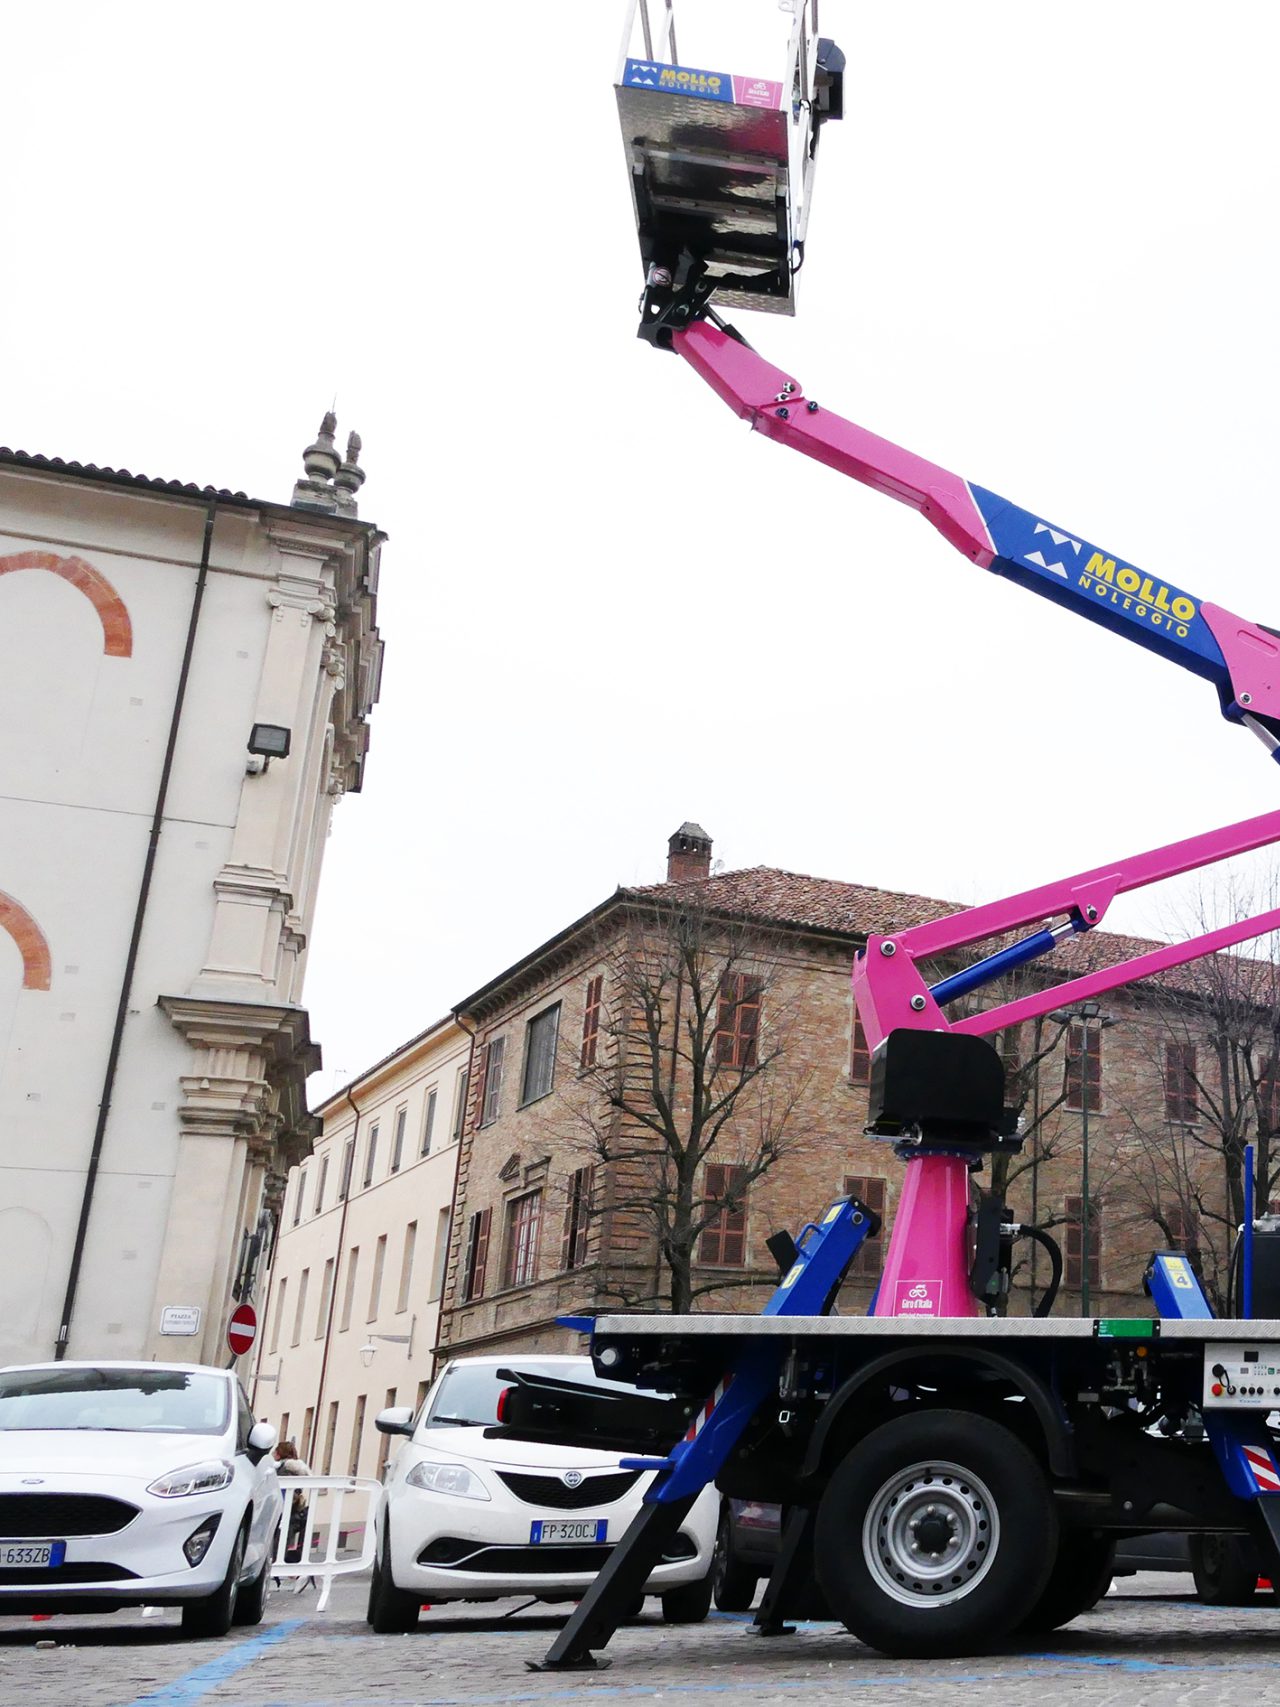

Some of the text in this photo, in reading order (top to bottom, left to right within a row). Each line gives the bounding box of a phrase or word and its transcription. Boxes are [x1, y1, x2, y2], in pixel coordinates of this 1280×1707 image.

[658, 80, 720, 95] NOLEGGIO
[661, 69, 721, 86] MOLLO
[1078, 575, 1189, 638] NOLEGGIO
[1084, 552, 1196, 621] MOLLO
